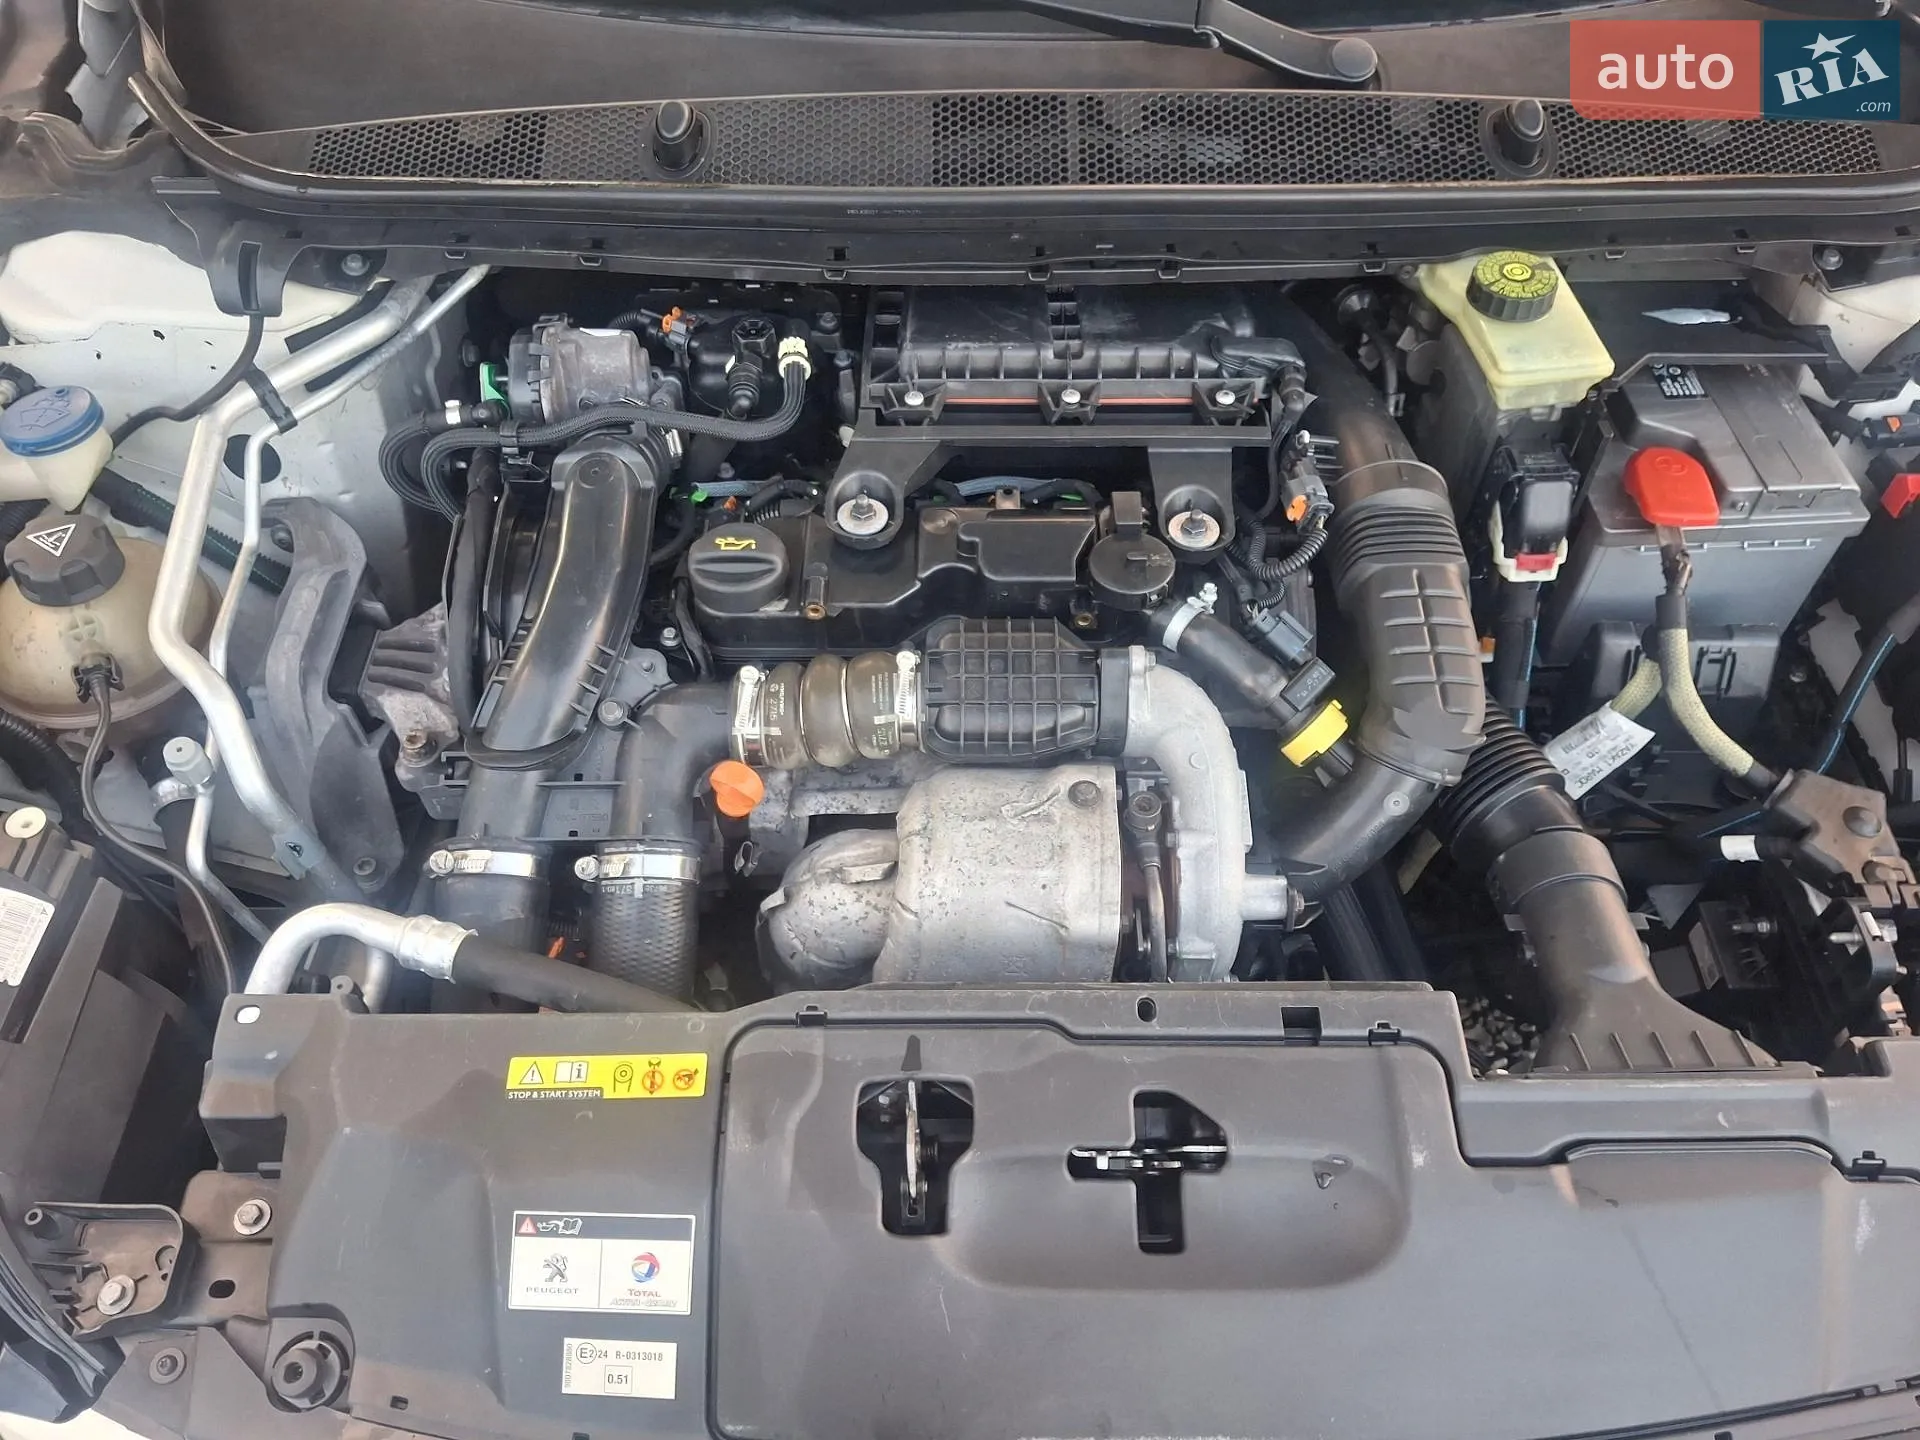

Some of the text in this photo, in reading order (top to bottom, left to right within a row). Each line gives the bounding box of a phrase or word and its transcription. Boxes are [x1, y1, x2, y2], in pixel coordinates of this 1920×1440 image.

[508, 1091, 531, 1099] STOP
[540, 1090, 567, 1098] START
[568, 1089, 600, 1097] SYSTEM
[525, 1286, 579, 1295] PEUGEOT
[615, 1350, 663, 1361] R-0313018
[607, 1373, 629, 1385] 0.51
